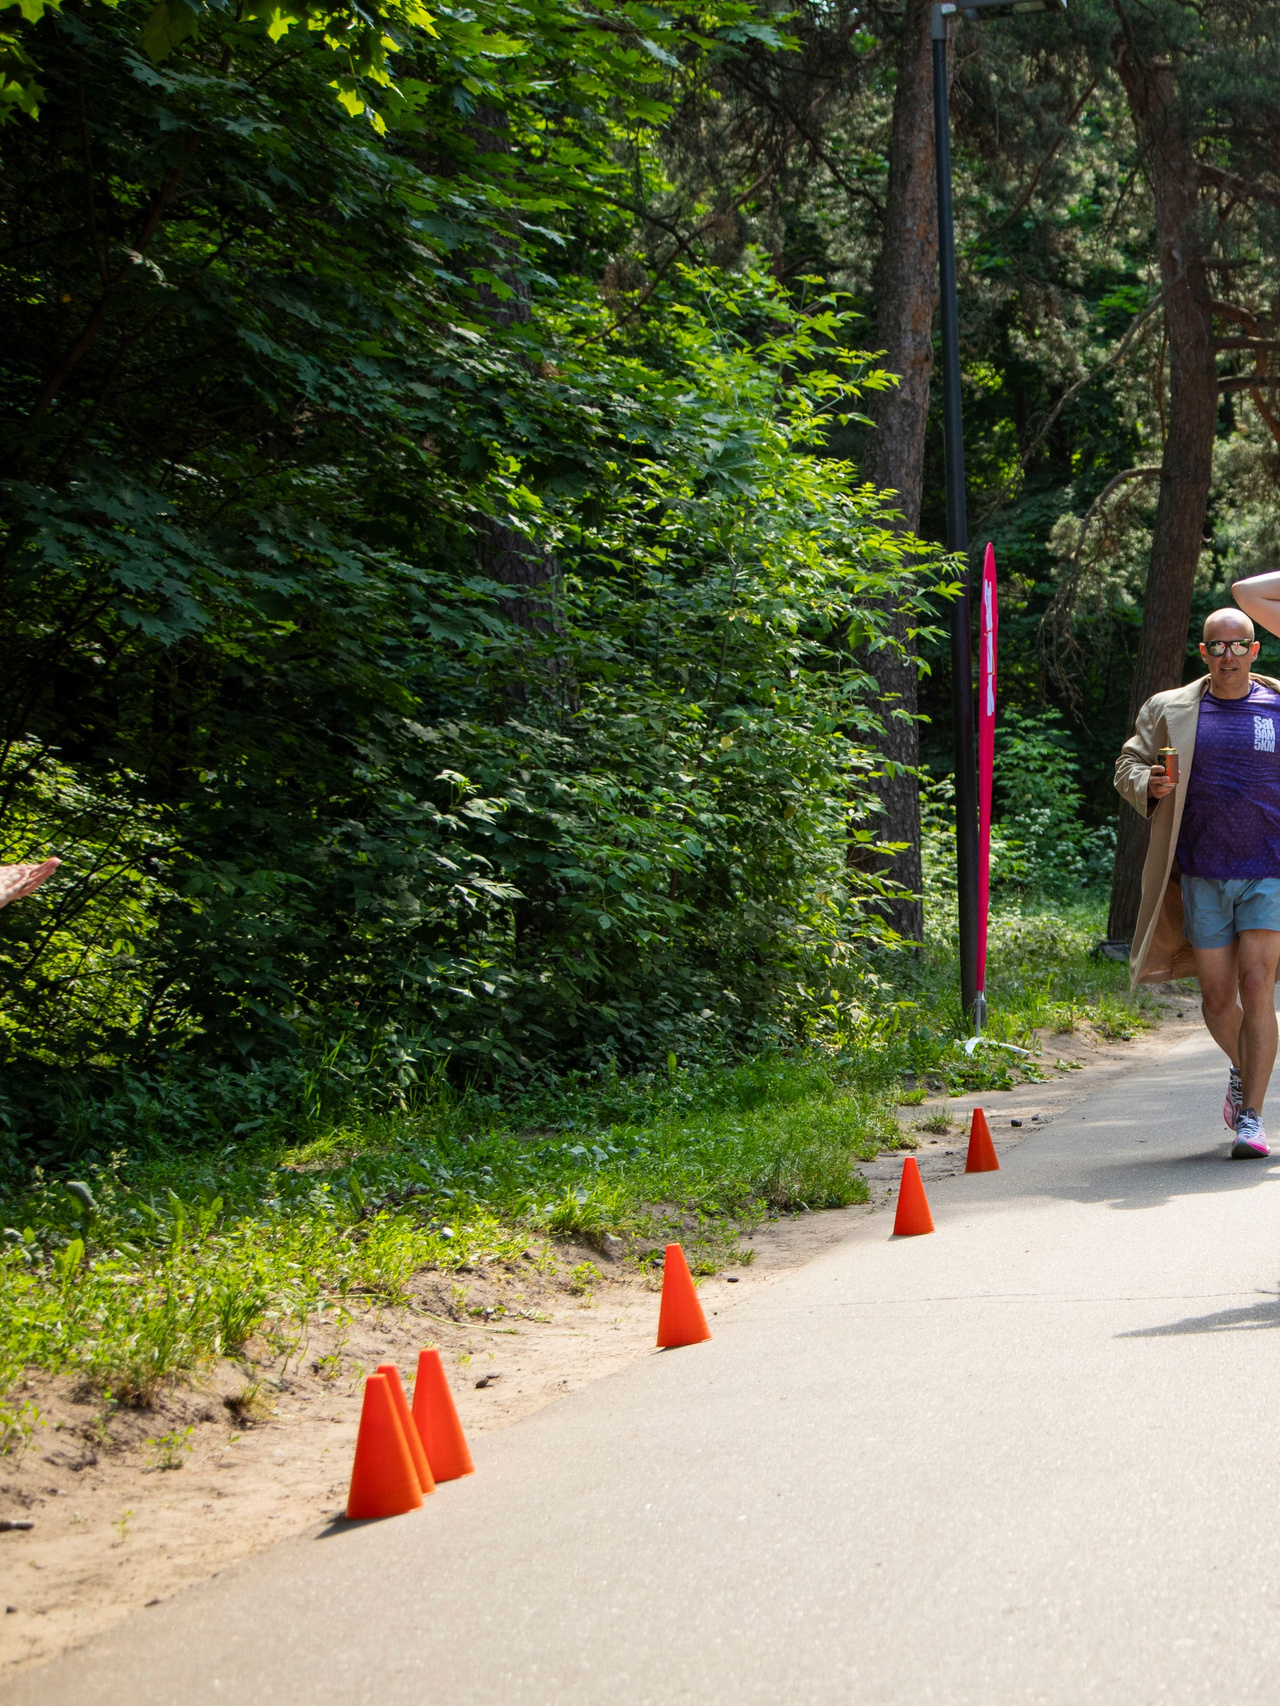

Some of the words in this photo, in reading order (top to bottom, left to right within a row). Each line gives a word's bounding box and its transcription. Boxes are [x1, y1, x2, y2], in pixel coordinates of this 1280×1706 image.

[1253, 715, 1274, 730] Sat
[1254, 728, 1275, 740] 9AM
[1254, 739, 1275, 753] 5KM
